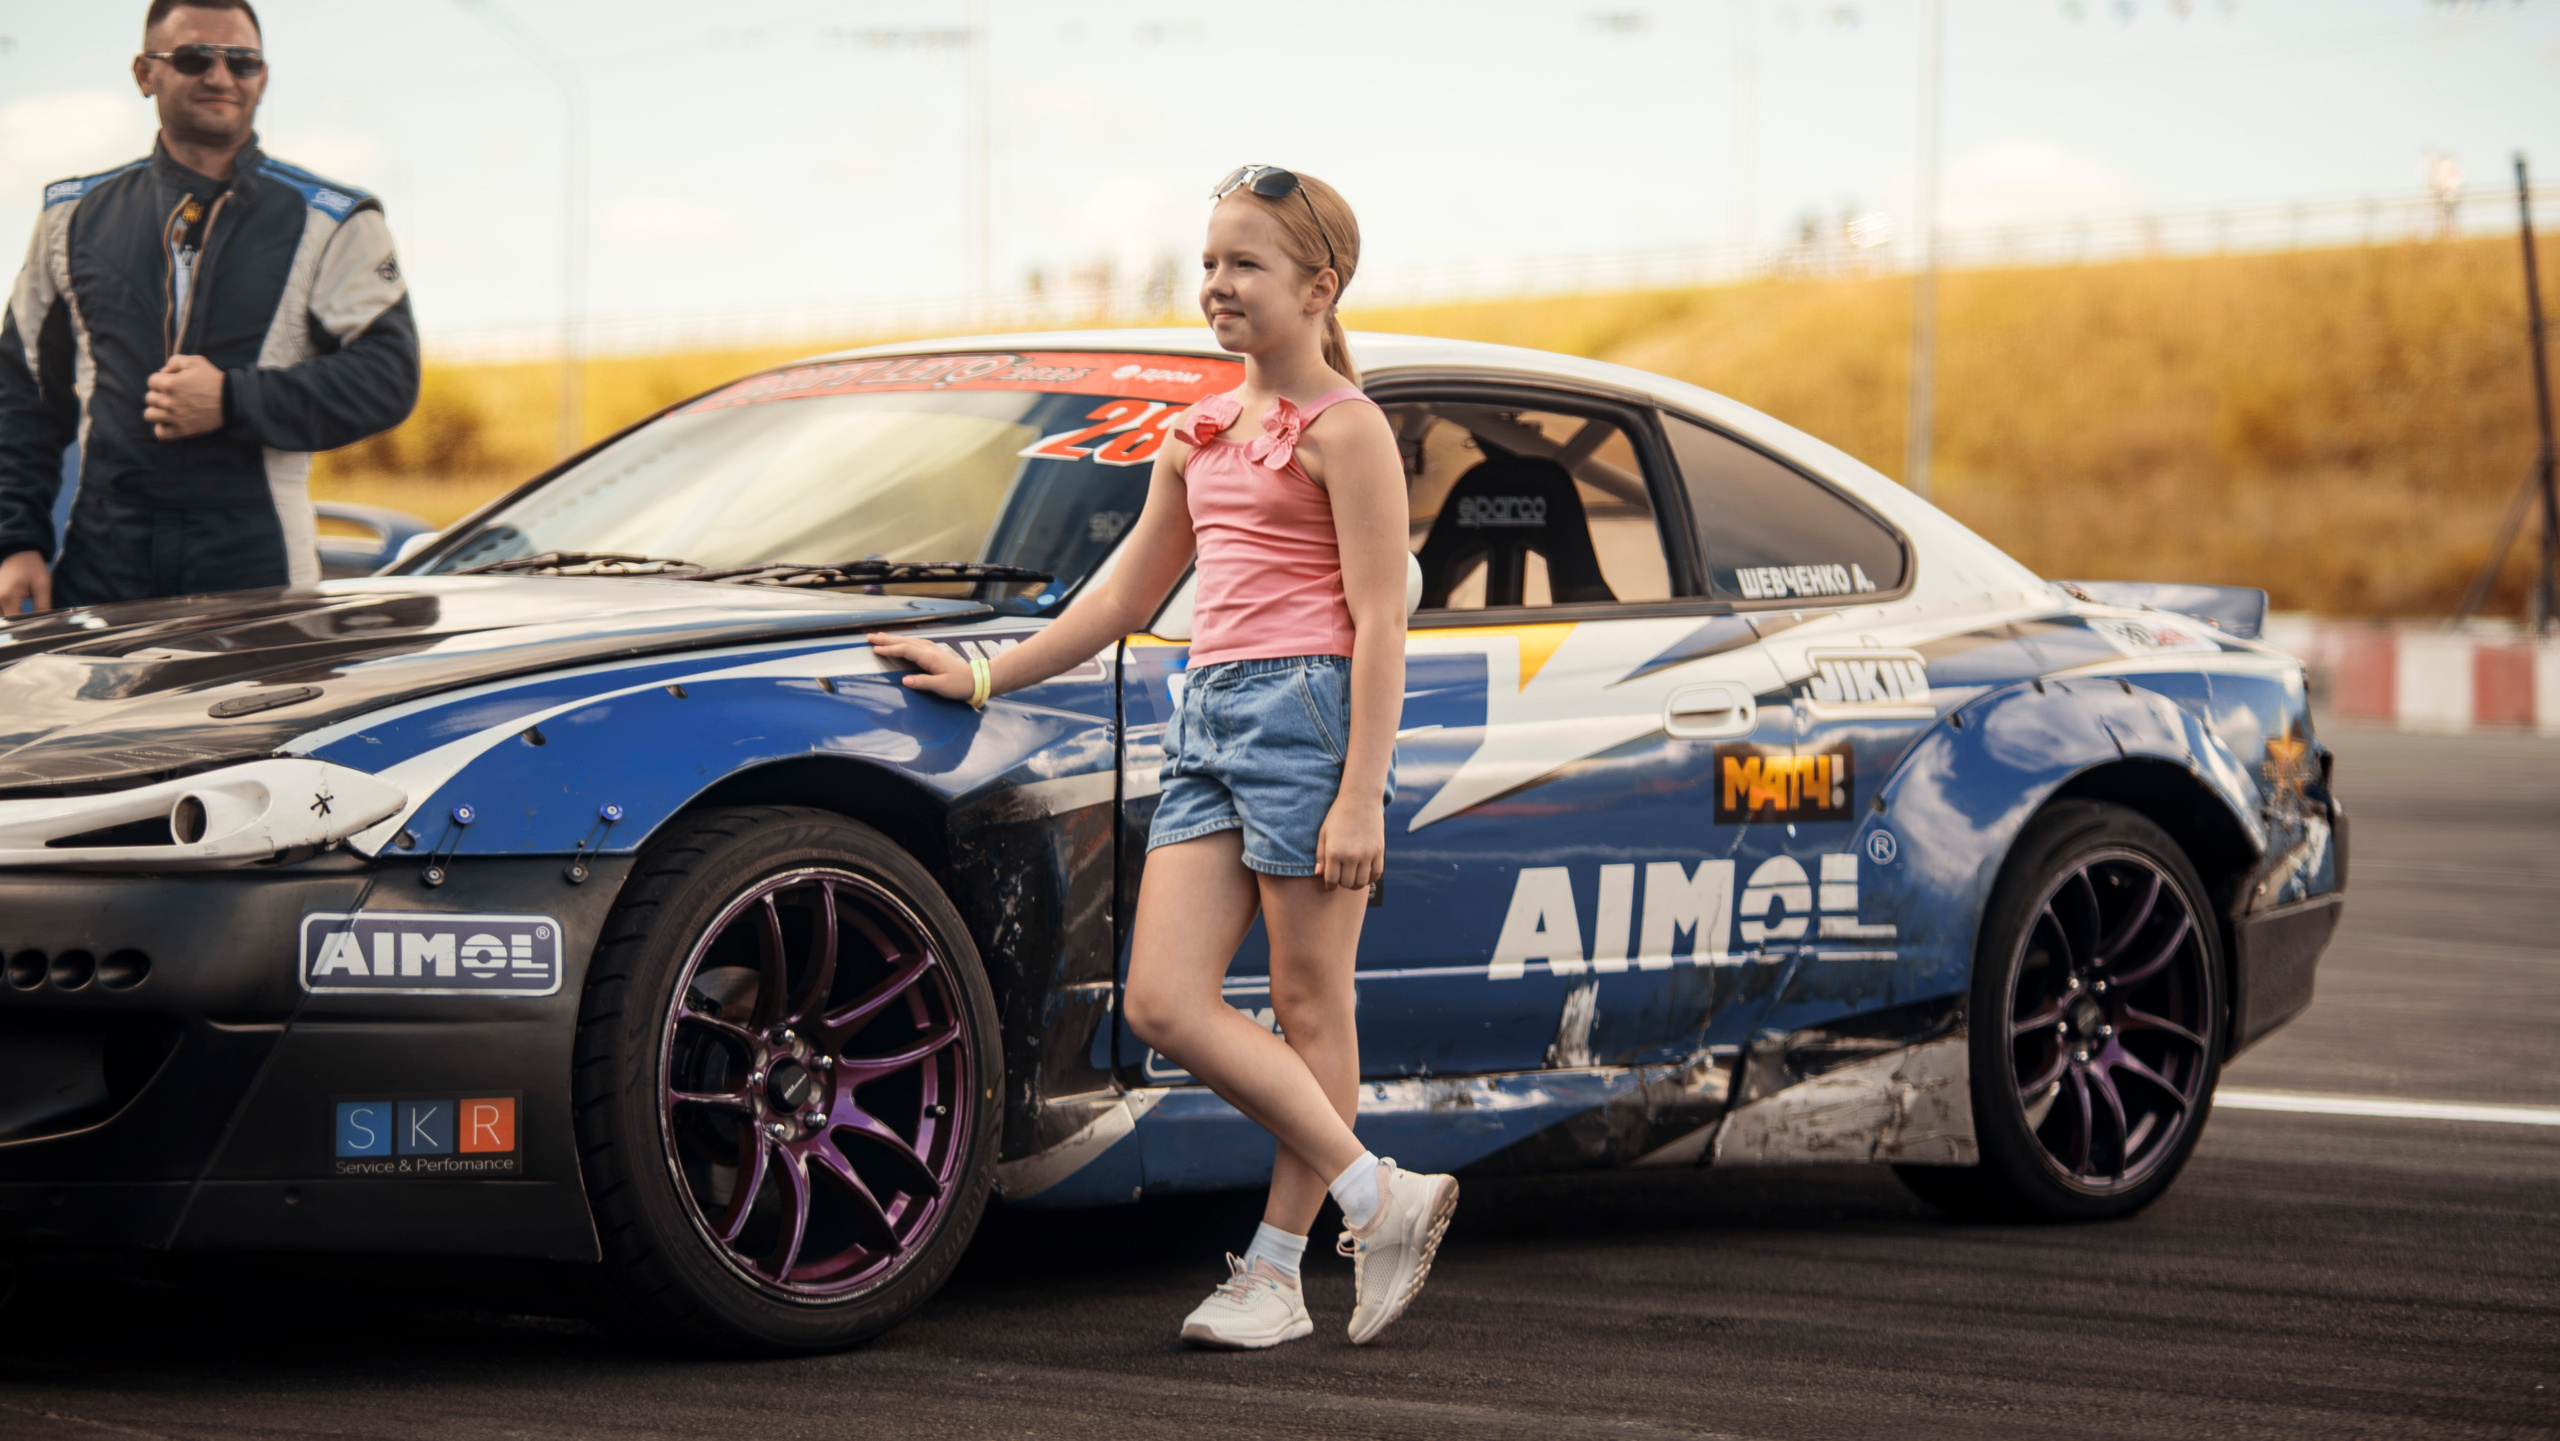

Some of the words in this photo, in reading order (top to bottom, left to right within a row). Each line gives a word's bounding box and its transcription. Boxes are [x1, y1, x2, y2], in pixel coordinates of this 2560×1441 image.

[1018, 399, 1184, 467] 28
[1735, 564, 1850, 599] ШЕВЧЕНКО
[1850, 563, 1876, 593] А.
[1723, 754, 1845, 811] МАТЧ!
[1488, 853, 1898, 980] AIMOL
[311, 932, 549, 978] AIMOL
[336, 1160, 395, 1175] Service
[399, 1159, 412, 1173] &
[417, 1157, 514, 1173] Perfomance
